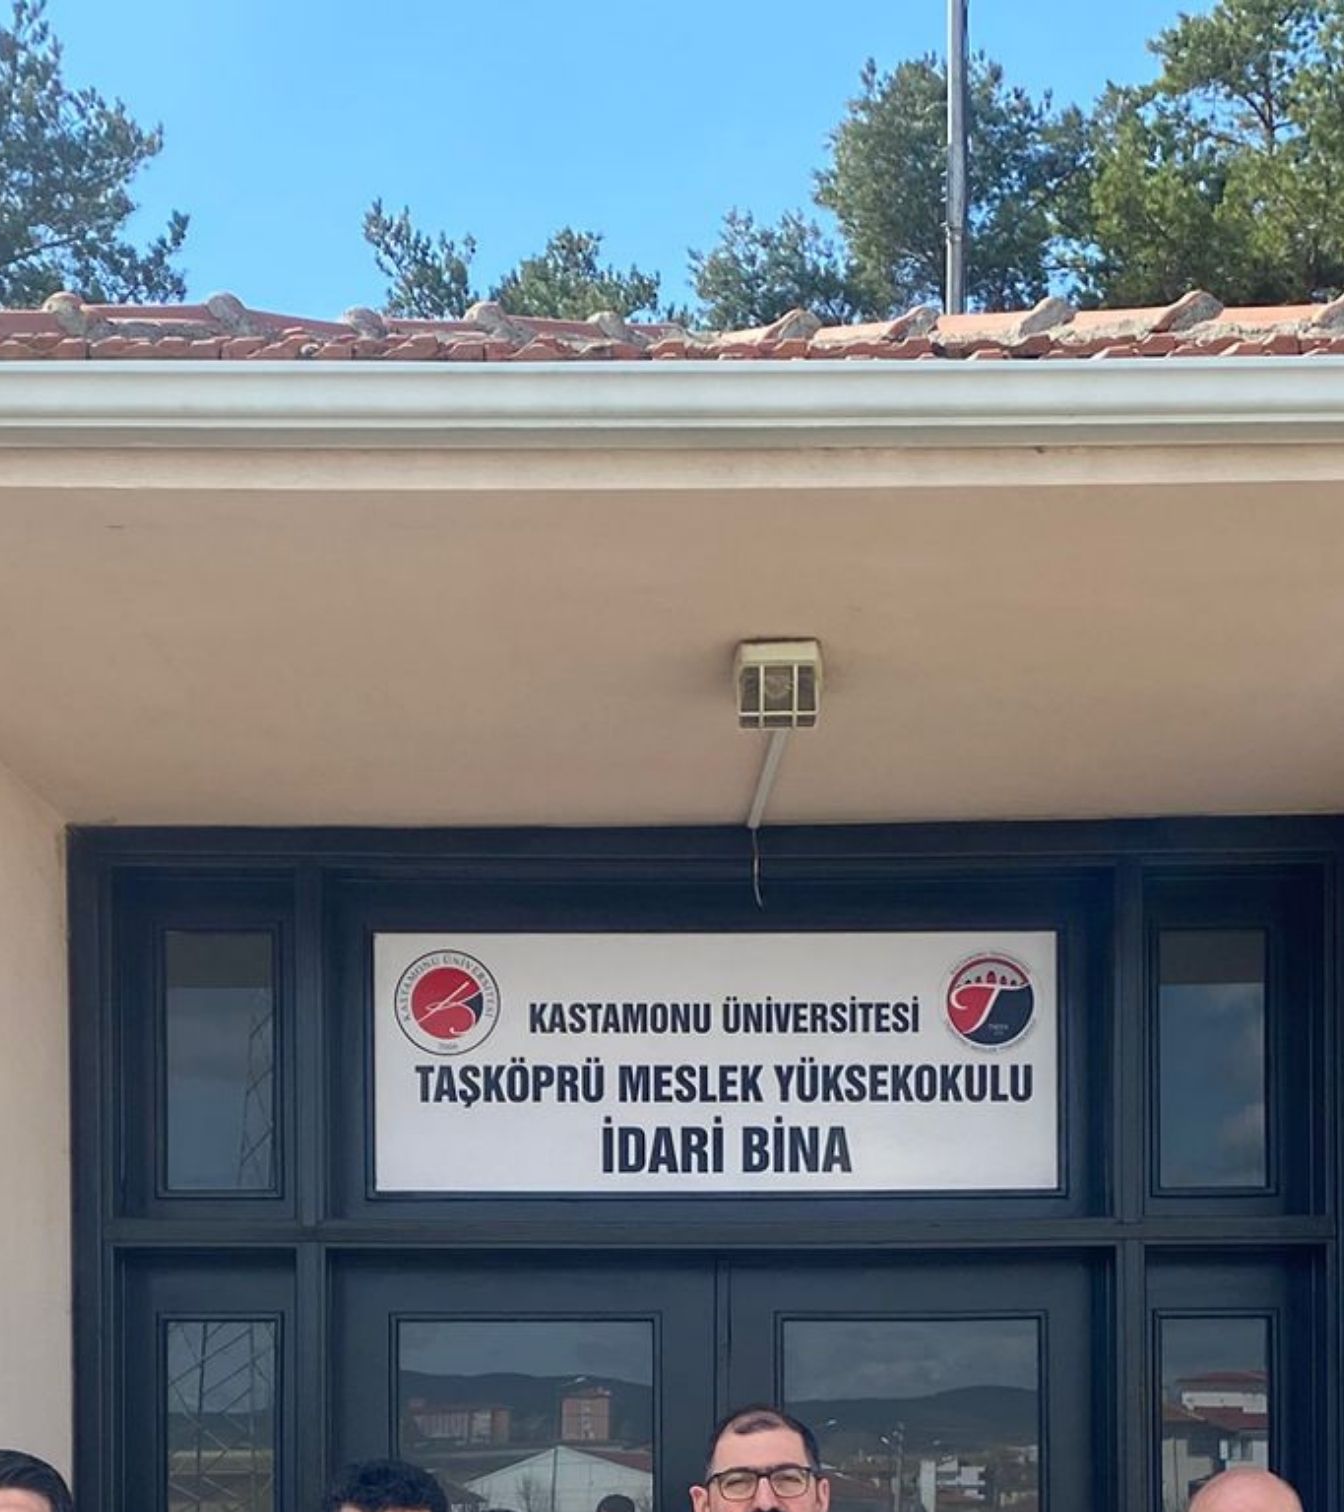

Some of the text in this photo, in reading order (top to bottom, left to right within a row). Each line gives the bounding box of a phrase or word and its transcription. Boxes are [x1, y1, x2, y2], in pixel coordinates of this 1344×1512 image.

[529, 996, 919, 1033] KASTAMONU ÜNİVERSİTESİ
[415, 1057, 1032, 1107] TAŞKÖPRÜ MESLEK YÜKSEKOKULU
[603, 1116, 851, 1173] İDARİ BİNA
